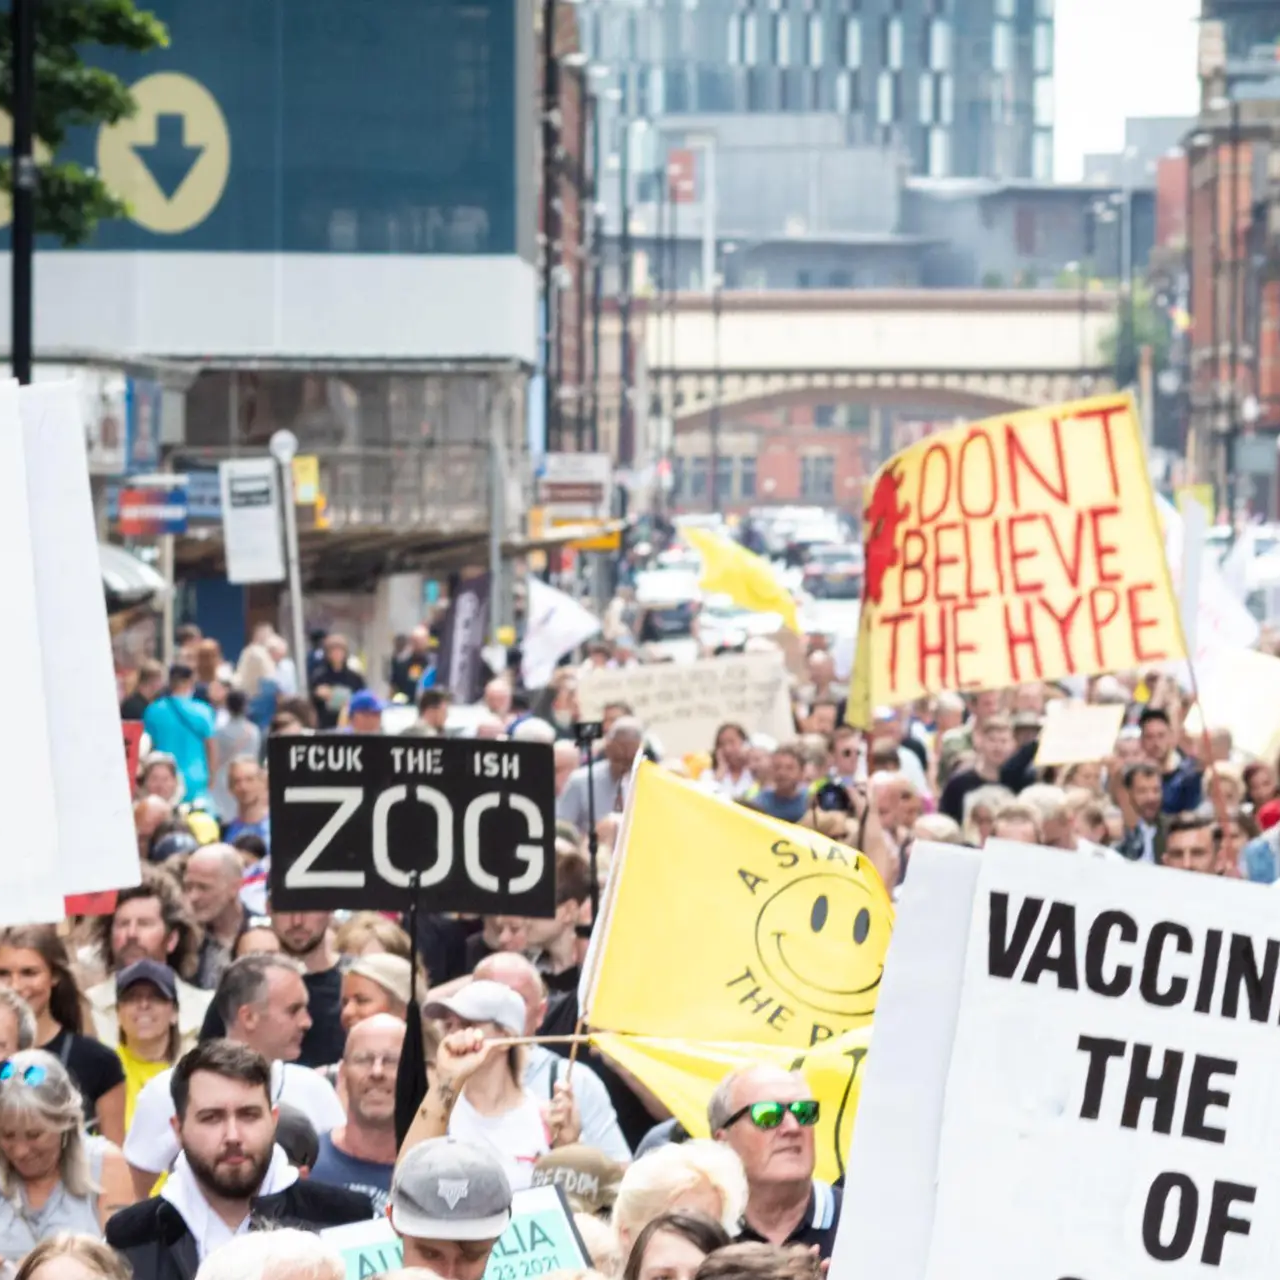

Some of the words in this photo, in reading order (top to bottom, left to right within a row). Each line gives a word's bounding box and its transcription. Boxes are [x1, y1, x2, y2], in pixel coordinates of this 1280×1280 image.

[900, 505, 1122, 607] BELIEVE
[880, 602, 982, 692] THE
[1003, 582, 1167, 682] HYPE
[290, 745, 363, 772] FCUK
[391, 747, 443, 774] THE
[474, 751, 520, 780] ISH
[284, 784, 544, 894] ZOG
[737, 868, 769, 895] A
[726, 965, 795, 1033] THE
[1078, 1035, 1238, 1143] THE
[1142, 1172, 1257, 1266] OF
